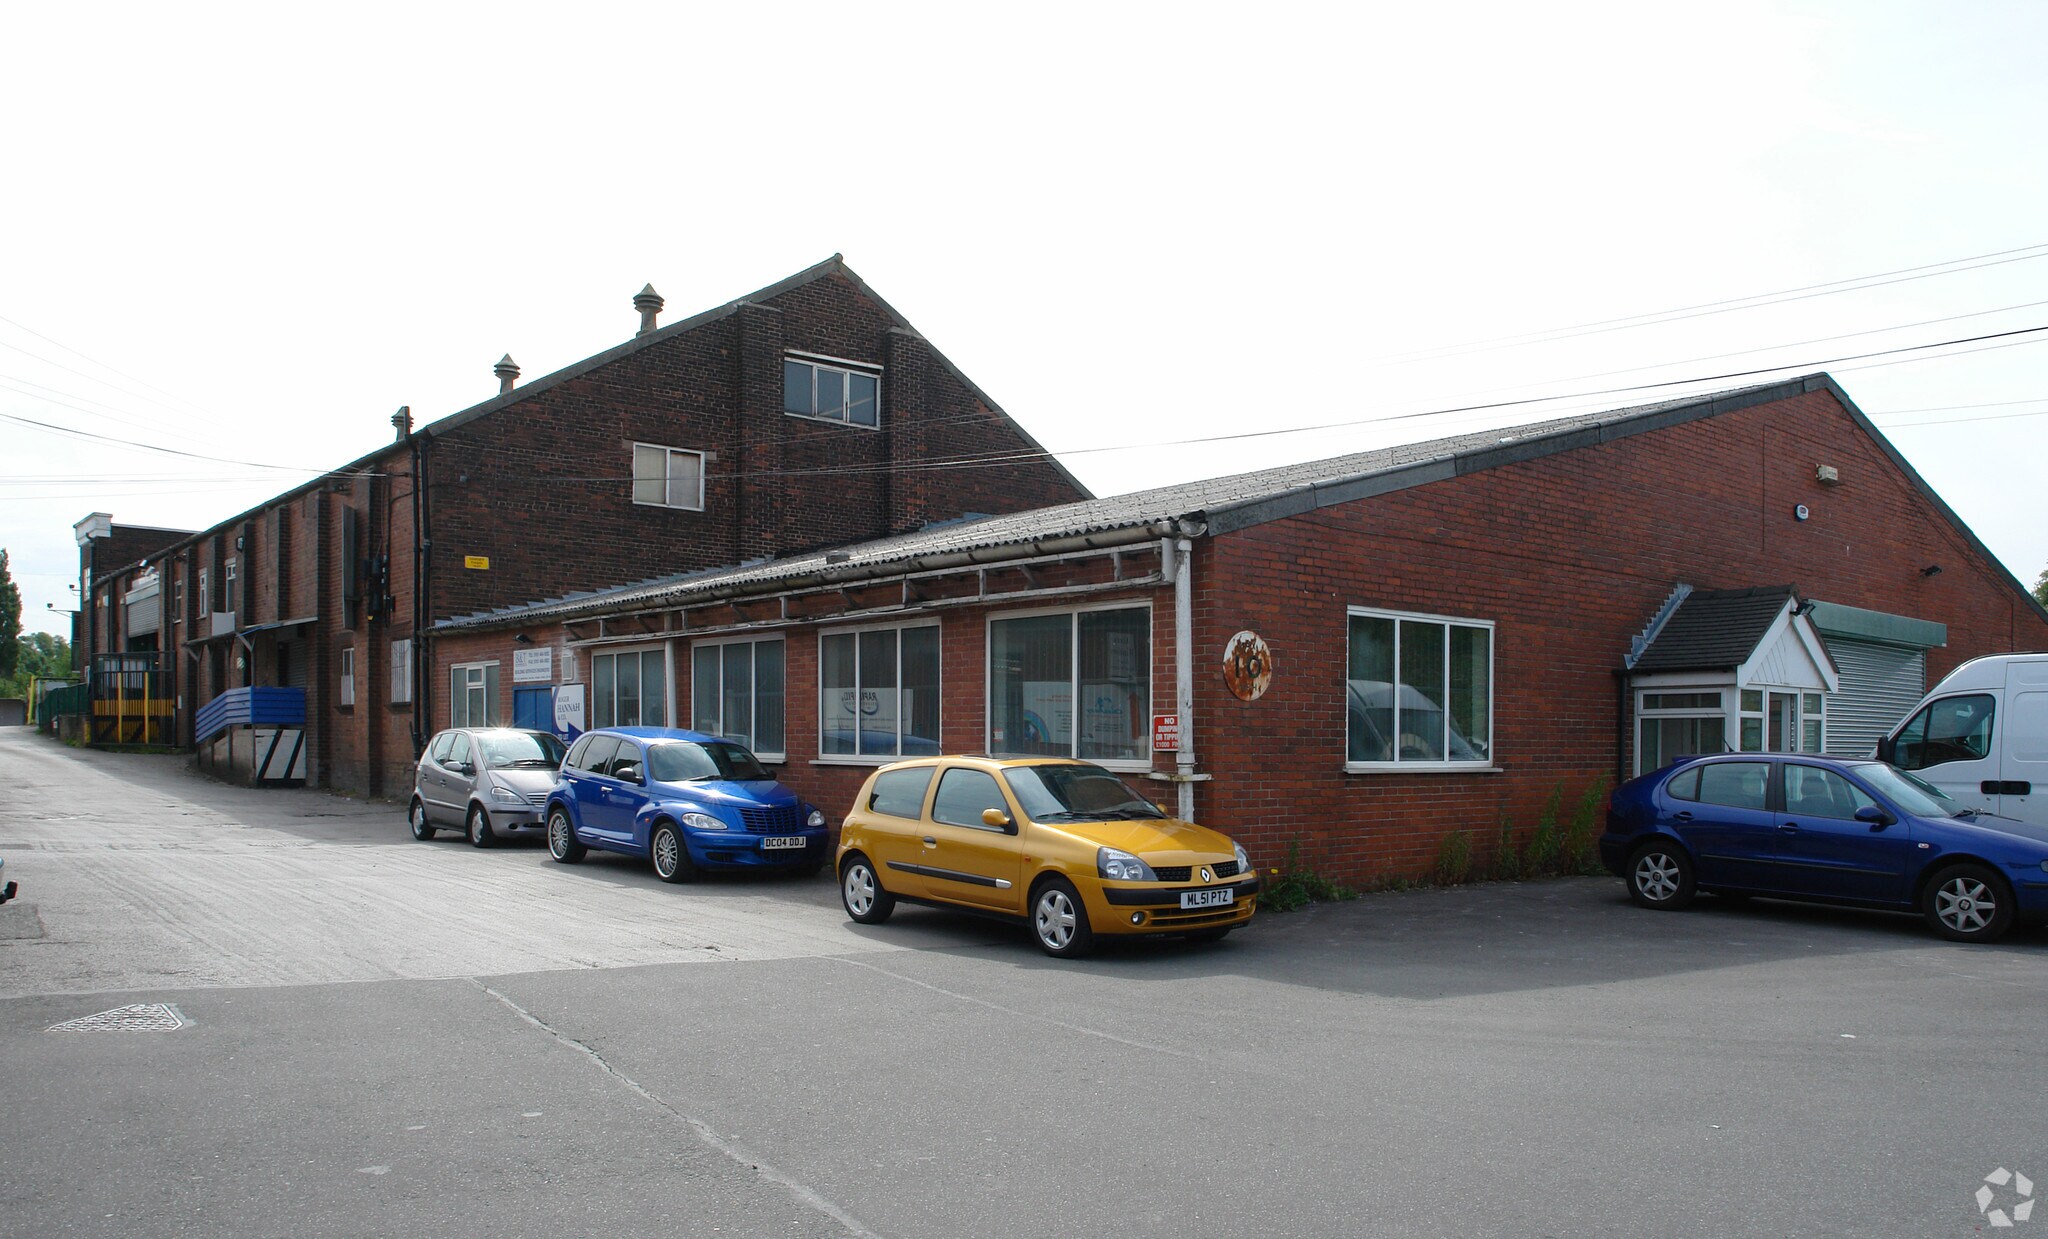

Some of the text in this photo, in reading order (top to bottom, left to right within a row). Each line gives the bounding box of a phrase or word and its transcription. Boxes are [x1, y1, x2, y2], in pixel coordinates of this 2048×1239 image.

[1235, 655, 1262, 679] 10
[557, 702, 580, 713] HANNAH
[1164, 717, 1175, 725] NO
[1155, 733, 1163, 741] OR
[765, 837, 805, 847] DC04 DDJ
[1187, 890, 1228, 906] ML51 PTZ
